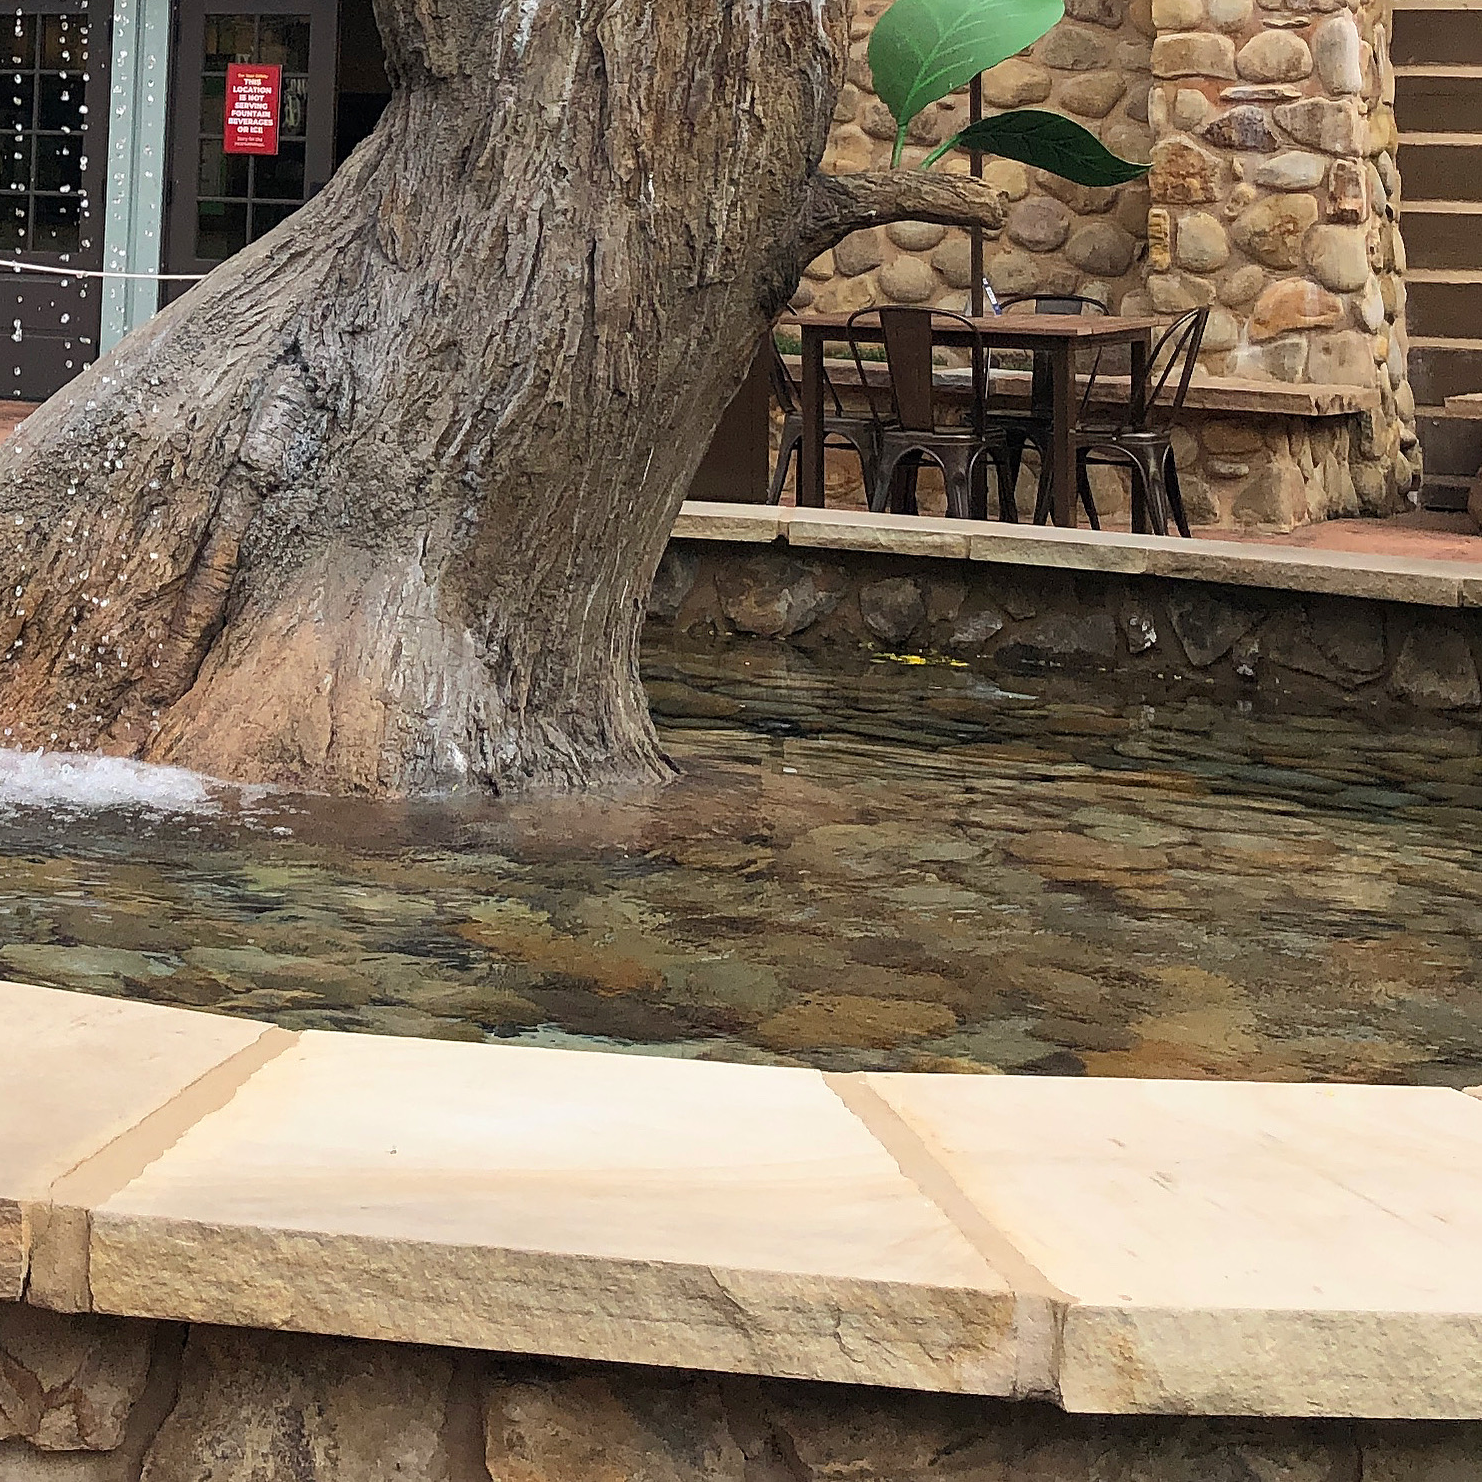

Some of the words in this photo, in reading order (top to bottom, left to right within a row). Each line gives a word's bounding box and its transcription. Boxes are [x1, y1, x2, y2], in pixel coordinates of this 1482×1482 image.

[244, 78, 262, 86] THIS
[232, 86, 272, 94] LOCATION
[234, 102, 268, 110] SERVING
[231, 110, 271, 118] FOUNTAIN
[227, 117, 274, 126] BEVERAGES
[250, 126, 263, 134] ICE
